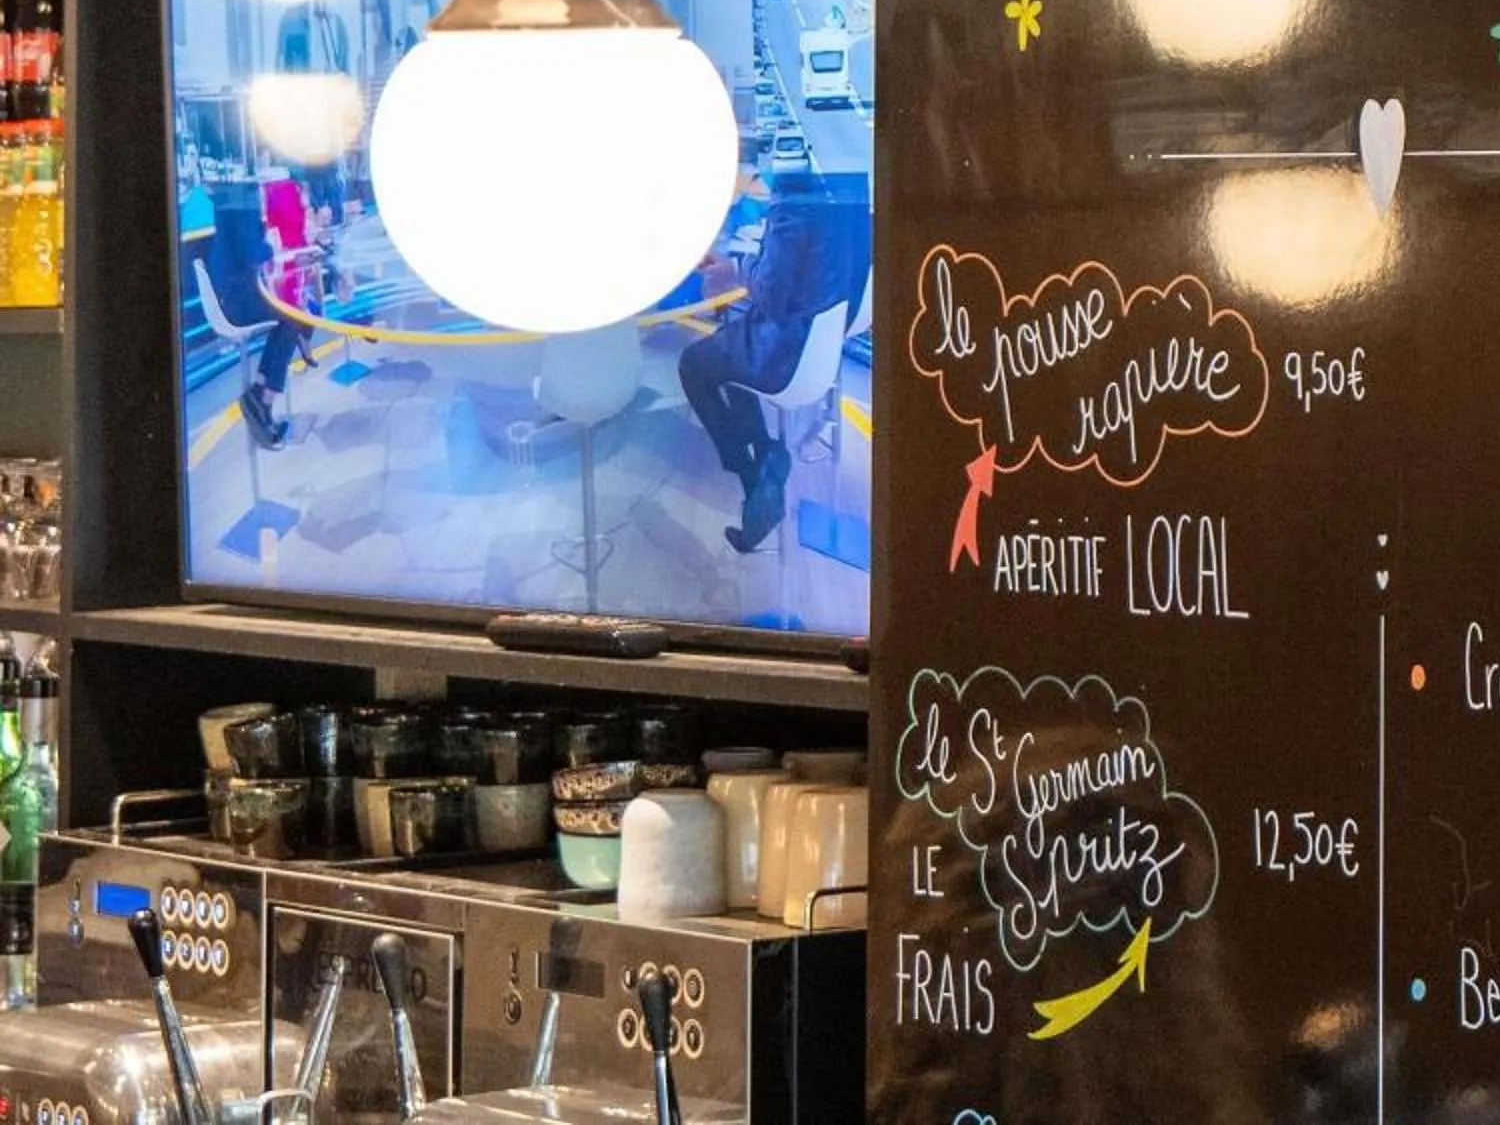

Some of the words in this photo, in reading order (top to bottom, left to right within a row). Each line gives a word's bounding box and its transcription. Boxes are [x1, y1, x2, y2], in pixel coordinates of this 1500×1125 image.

[983, 289, 1112, 443] pousse
[1285, 347, 1365, 413] 9,50€
[1127, 515, 1249, 618] LOCAL
[969, 708, 1006, 813] St
[1013, 728, 1155, 858] Germain
[913, 846, 944, 896] LE
[1002, 806, 1185, 939] Spritz
[1254, 808, 1359, 882] 12,50€
[896, 934, 995, 1034] FRAIS
